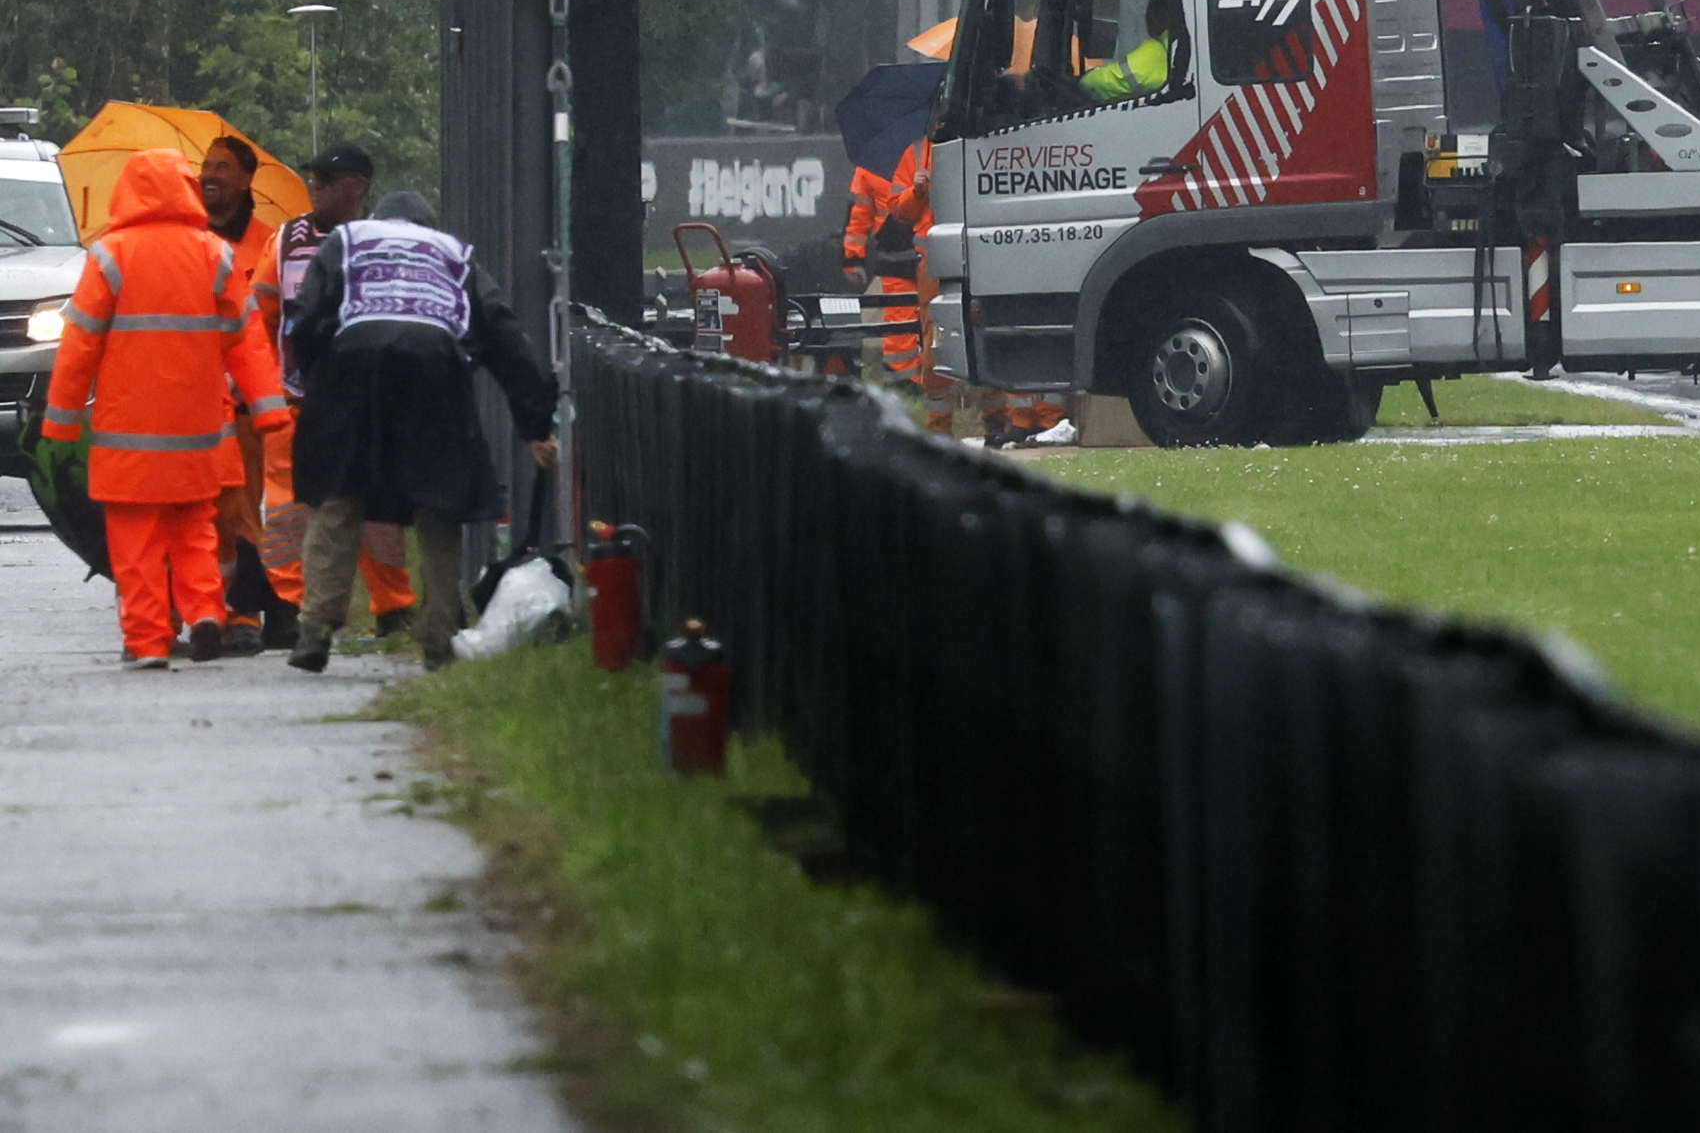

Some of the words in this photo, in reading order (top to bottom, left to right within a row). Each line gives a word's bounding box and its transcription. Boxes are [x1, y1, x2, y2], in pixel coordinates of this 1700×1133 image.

[977, 144, 1094, 171] VERVIERS
[977, 166, 1128, 195] DÉPANNAGE
[993, 224, 1103, 245] 087.35.18.20
